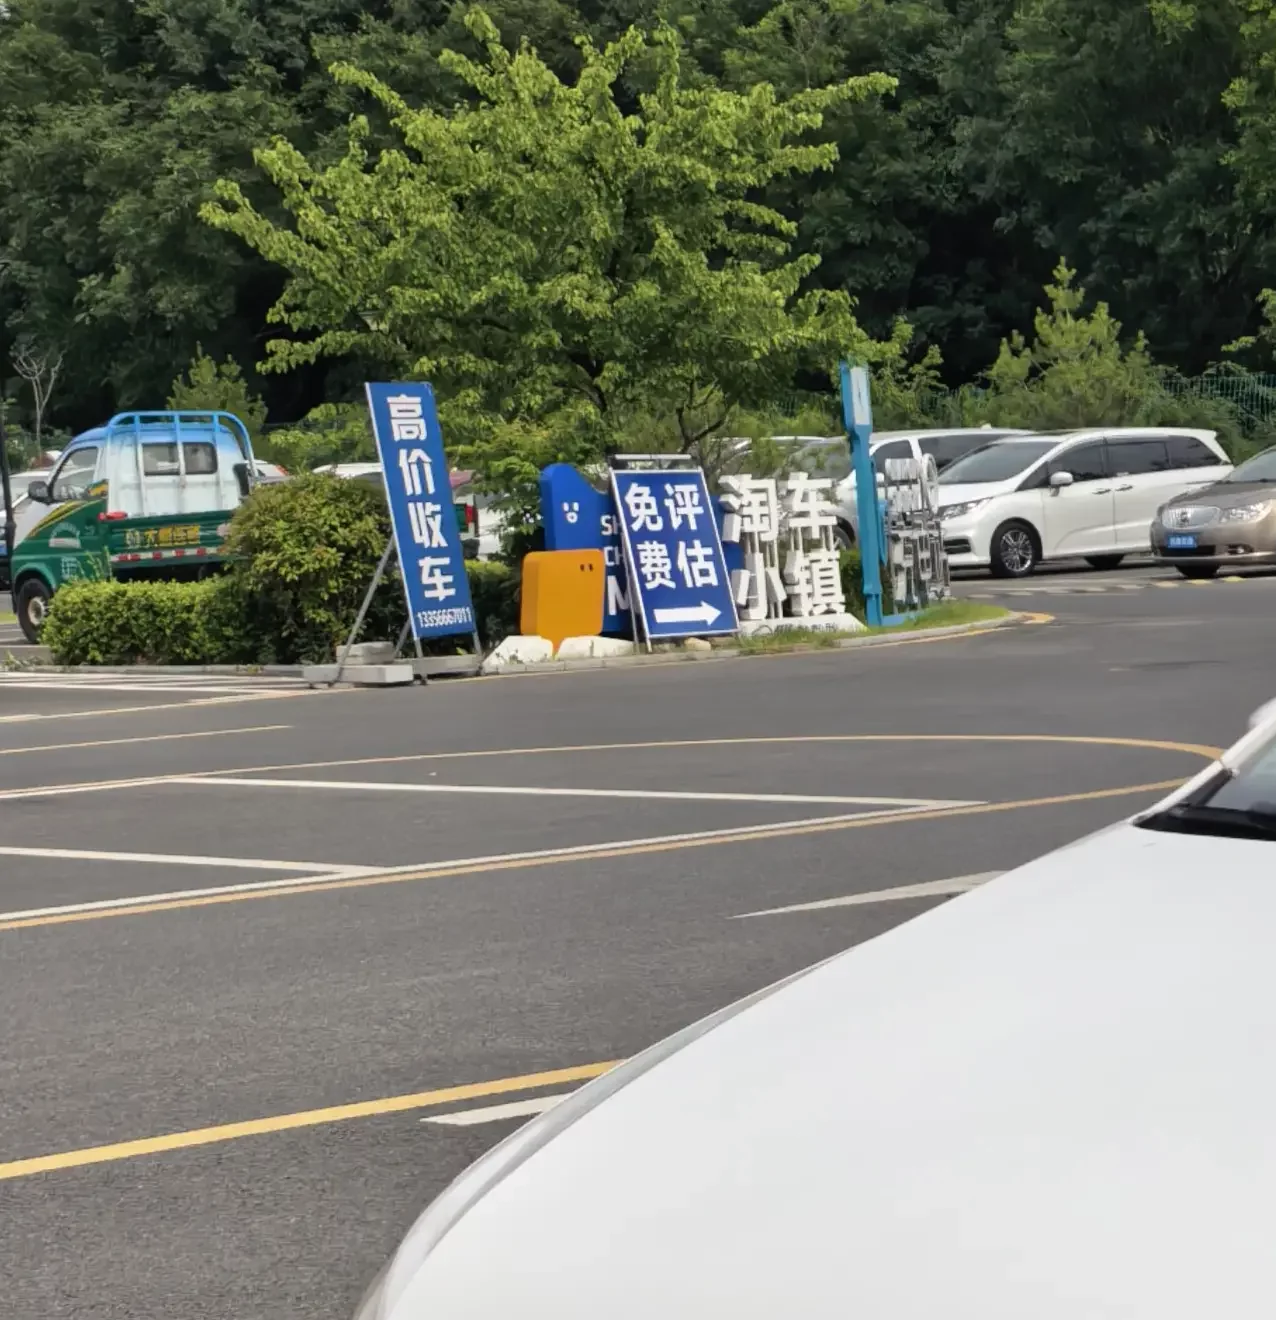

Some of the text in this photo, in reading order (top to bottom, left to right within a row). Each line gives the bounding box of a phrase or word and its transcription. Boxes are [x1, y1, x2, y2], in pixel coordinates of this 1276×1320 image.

[387, 393, 456, 601] 高价收车
[719, 472, 837, 542] 淘车
[731, 549, 846, 620] 小镇
